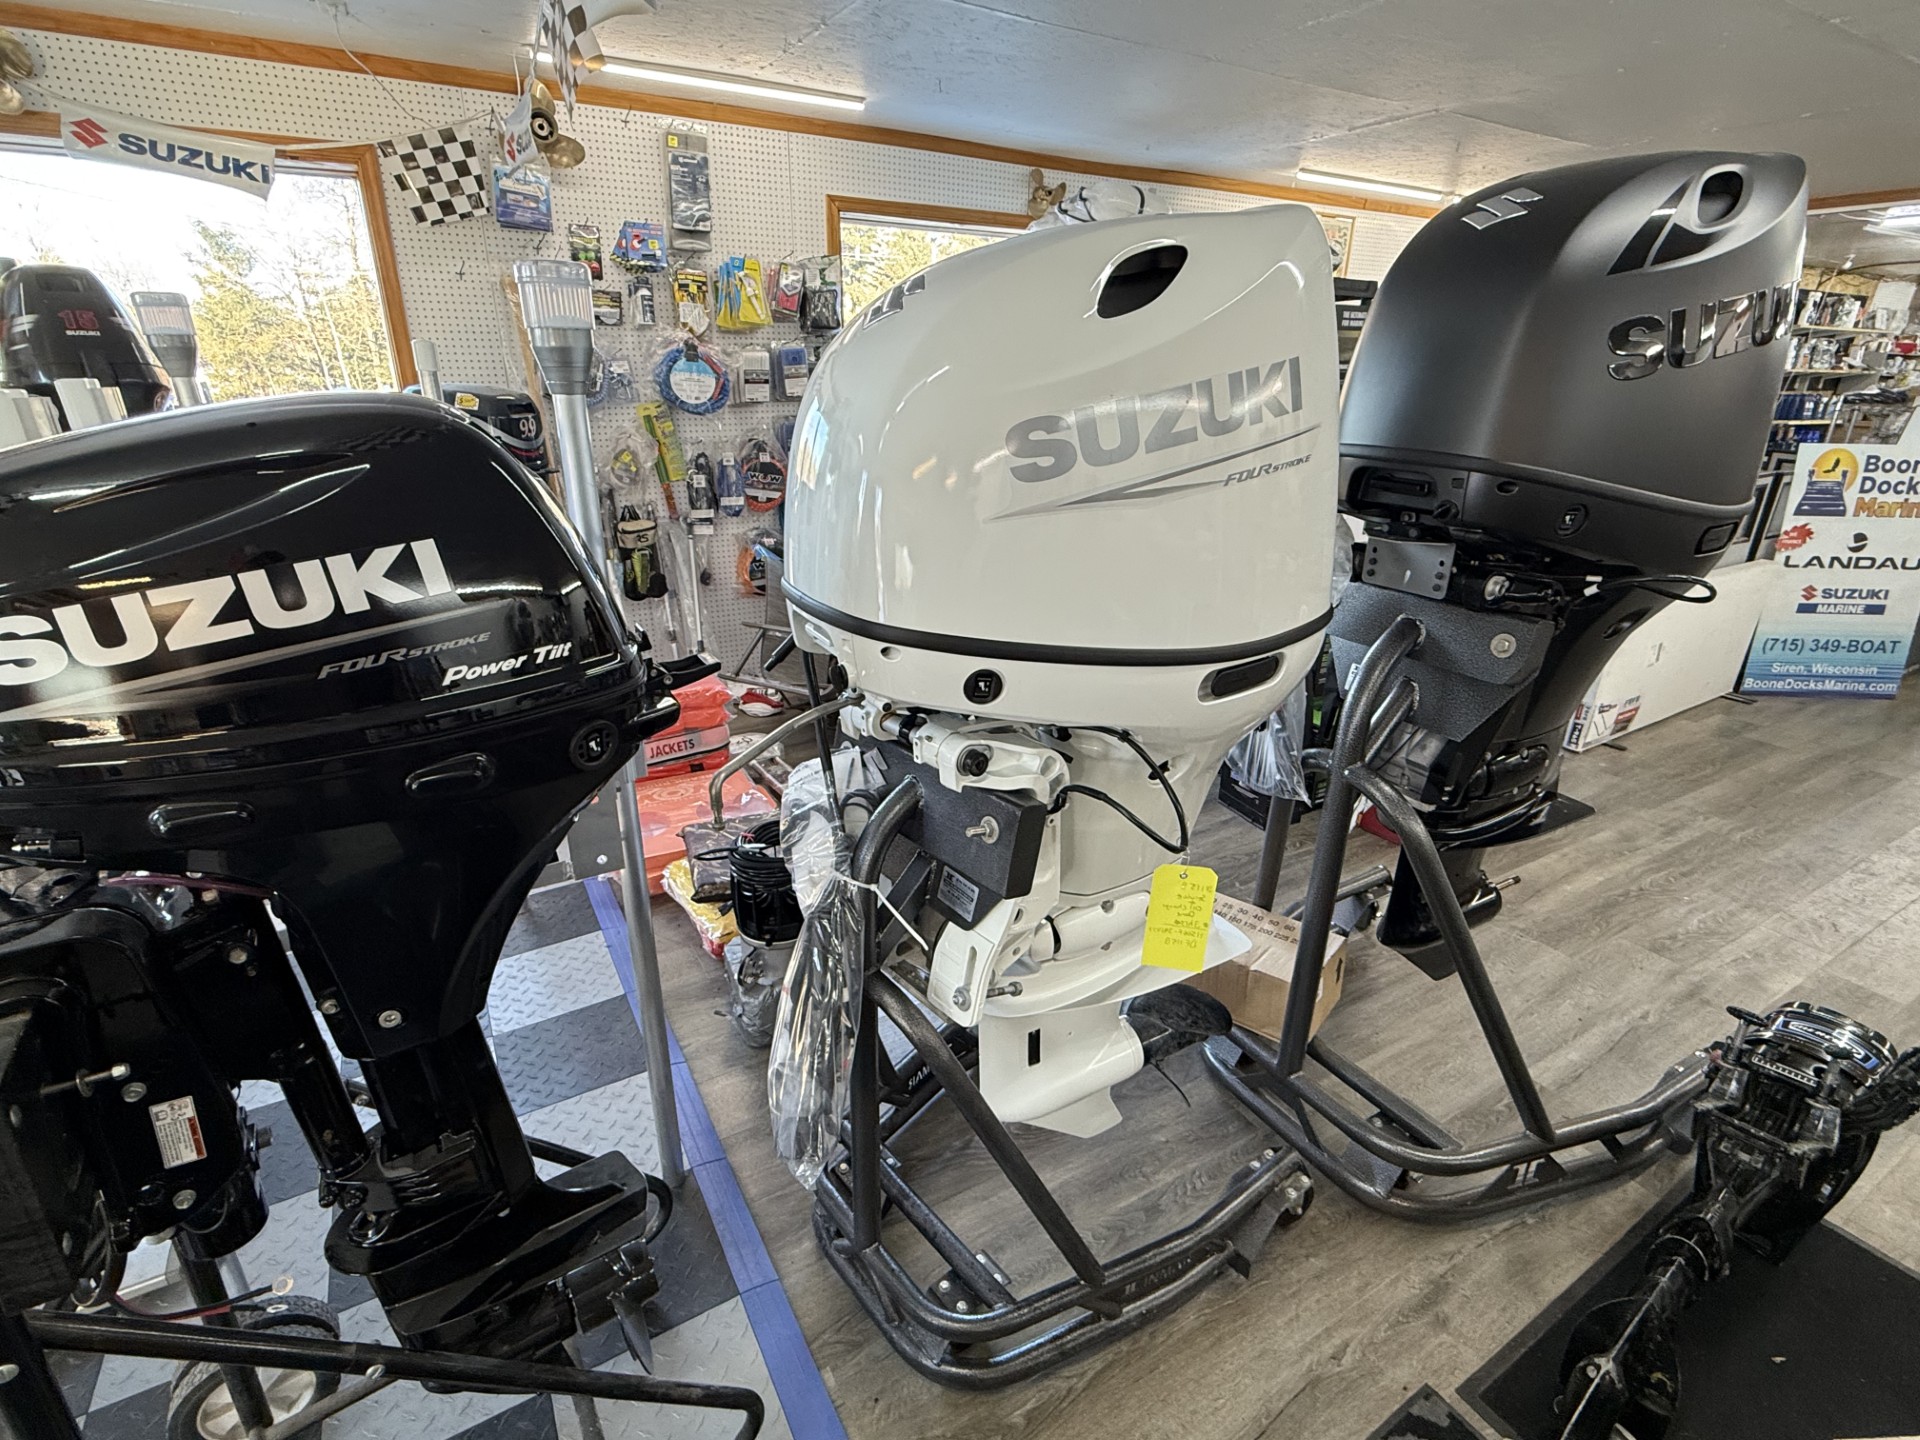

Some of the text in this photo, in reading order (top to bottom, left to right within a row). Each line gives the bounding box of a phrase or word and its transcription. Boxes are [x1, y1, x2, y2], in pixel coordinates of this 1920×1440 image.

[118, 132, 271, 185] SUZUKI
[57, 309, 99, 329] 15
[1005, 356, 1303, 483] SUZUKI
[748, 471, 782, 484] WOW
[1858, 475, 1920, 495] Dock
[1852, 496, 1920, 519] Marin
[1783, 555, 1920, 571] LANDAU
[1821, 587, 1890, 600] SUZUKI
[0, 538, 453, 686] SUZUKI
[1815, 604, 1866, 614] MARINE
[1762, 637, 1901, 655] (715) 349-BOAT
[442, 641, 573, 687] Power Tilt
[1771, 662, 1878, 675] Siren, Wisconsin
[1743, 677, 1898, 692] BooneDocksMarine.com
[650, 738, 695, 759] JACKETS
[1237, 907, 1249, 915] 30
[1252, 913, 1264, 922] 40
[1258, 927, 1273, 936] 200
